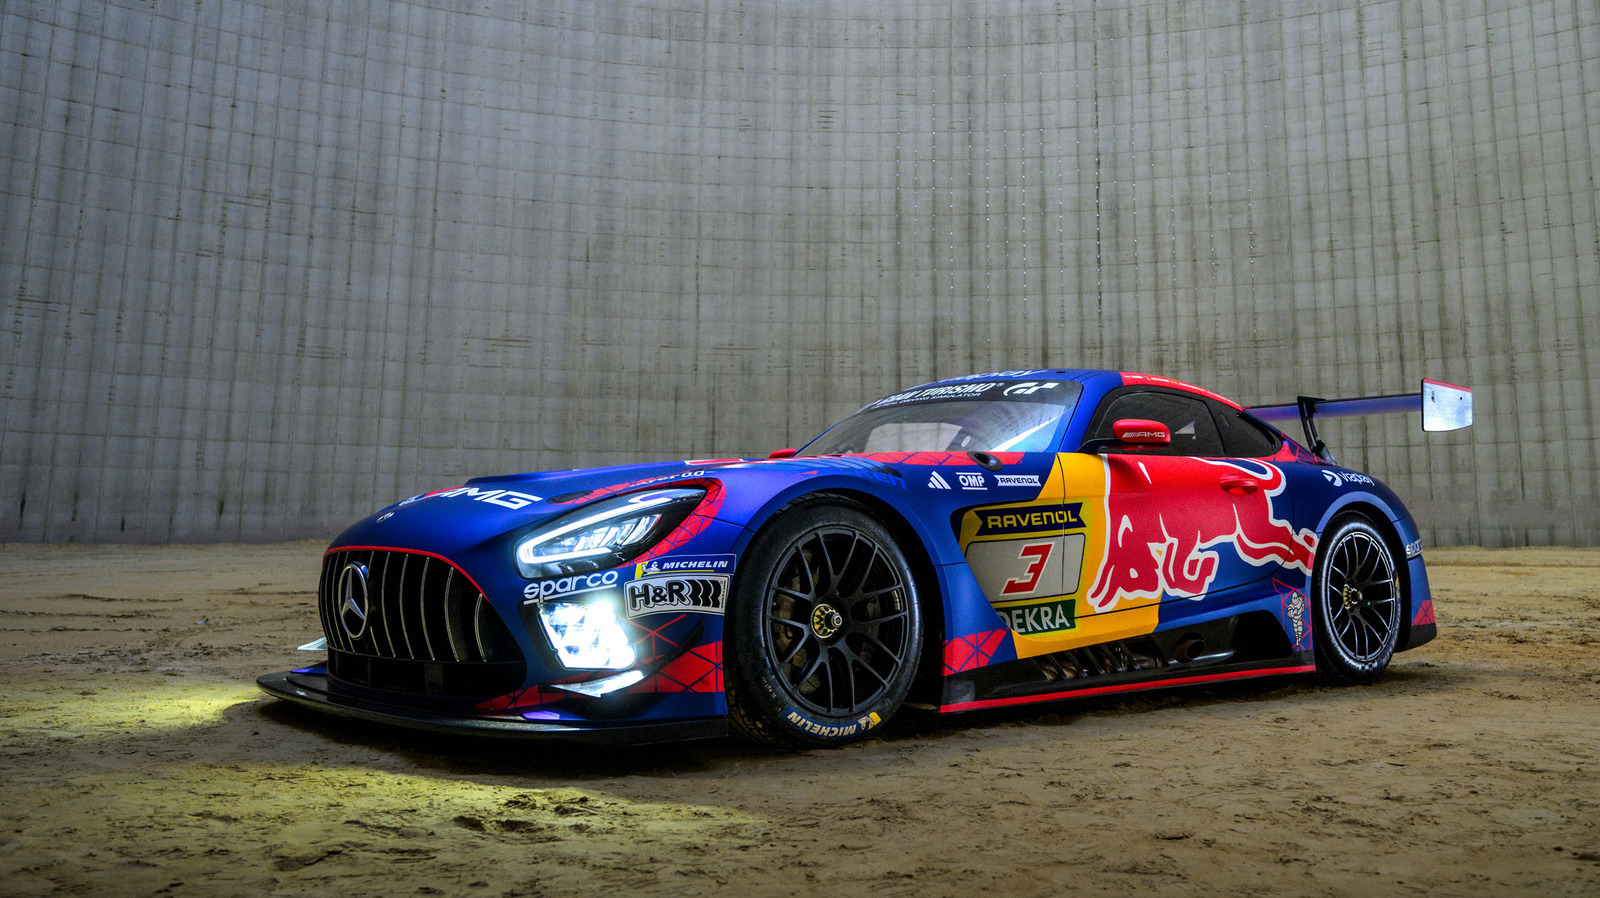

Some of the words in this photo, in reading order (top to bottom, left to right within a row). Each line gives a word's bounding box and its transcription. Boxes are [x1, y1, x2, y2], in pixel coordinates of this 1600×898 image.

[958, 474, 985, 488] OMP
[1000, 476, 1039, 485] RAVENOL
[987, 510, 1078, 529] RAVENOL
[662, 559, 729, 570] MICHELIN
[1000, 541, 1056, 596] 3
[523, 570, 619, 603] sparco
[629, 580, 687, 611] H&R
[786, 711, 857, 737] MICHELIN
